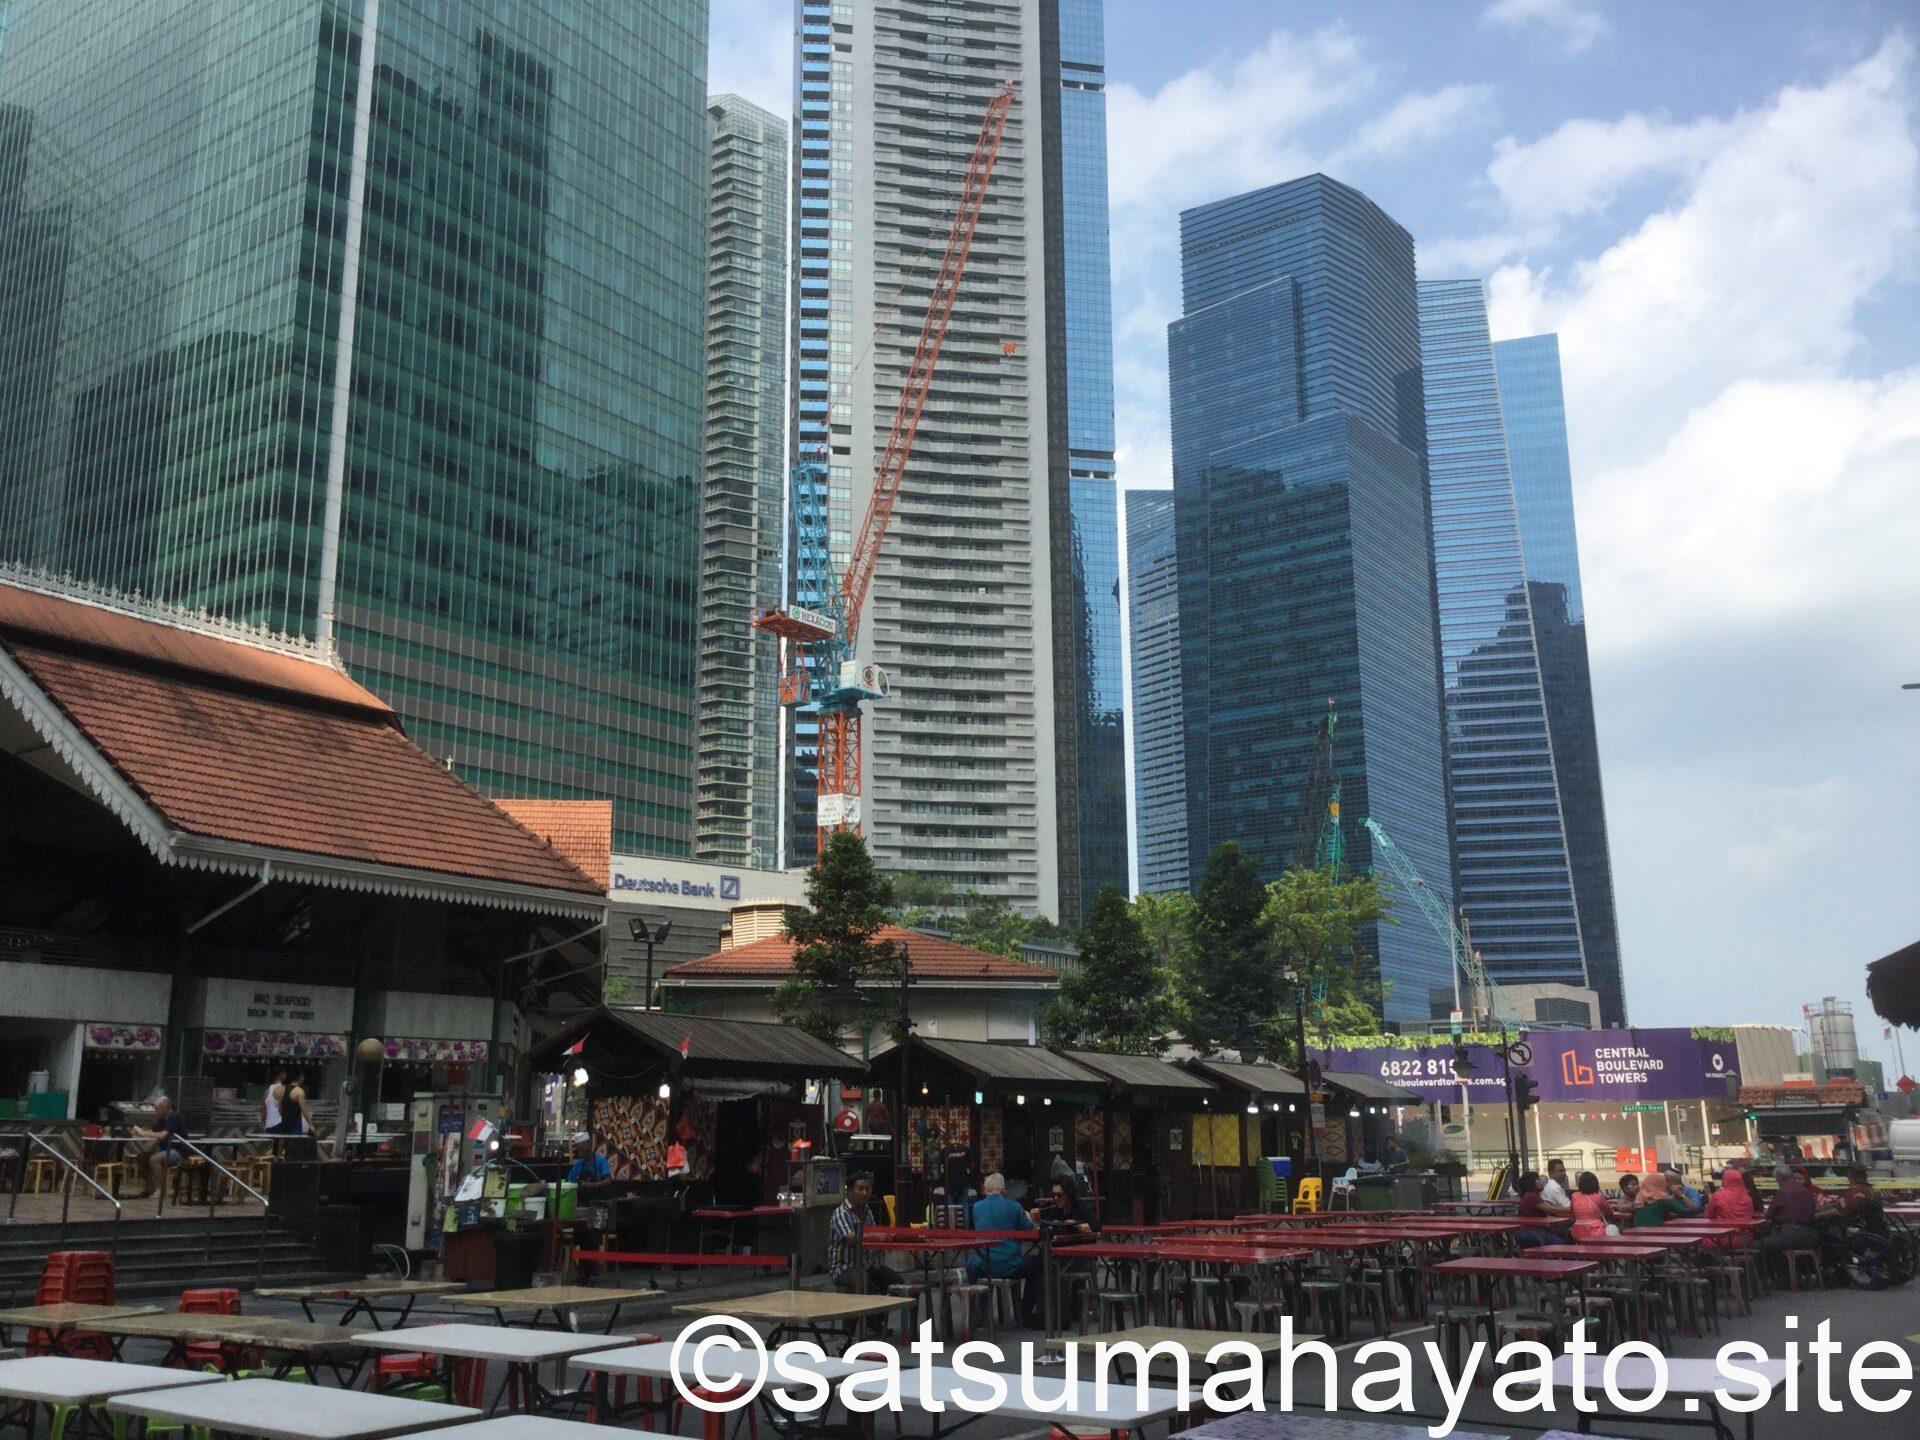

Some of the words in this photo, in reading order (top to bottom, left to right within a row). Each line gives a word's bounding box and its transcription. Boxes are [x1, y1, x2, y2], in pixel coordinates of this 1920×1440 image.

[801, 611, 834, 630] HEXACON
[614, 873, 679, 895] Deutsche
[681, 880, 715, 898] Bank
[274, 994, 311, 1007] SEAFOOD
[1595, 1047, 1650, 1059] CENTRAL
[1380, 1060, 1422, 1076] 6822
[1596, 1060, 1664, 1072] BOULEVARD
[1598, 1073, 1648, 1084] TOWERS
